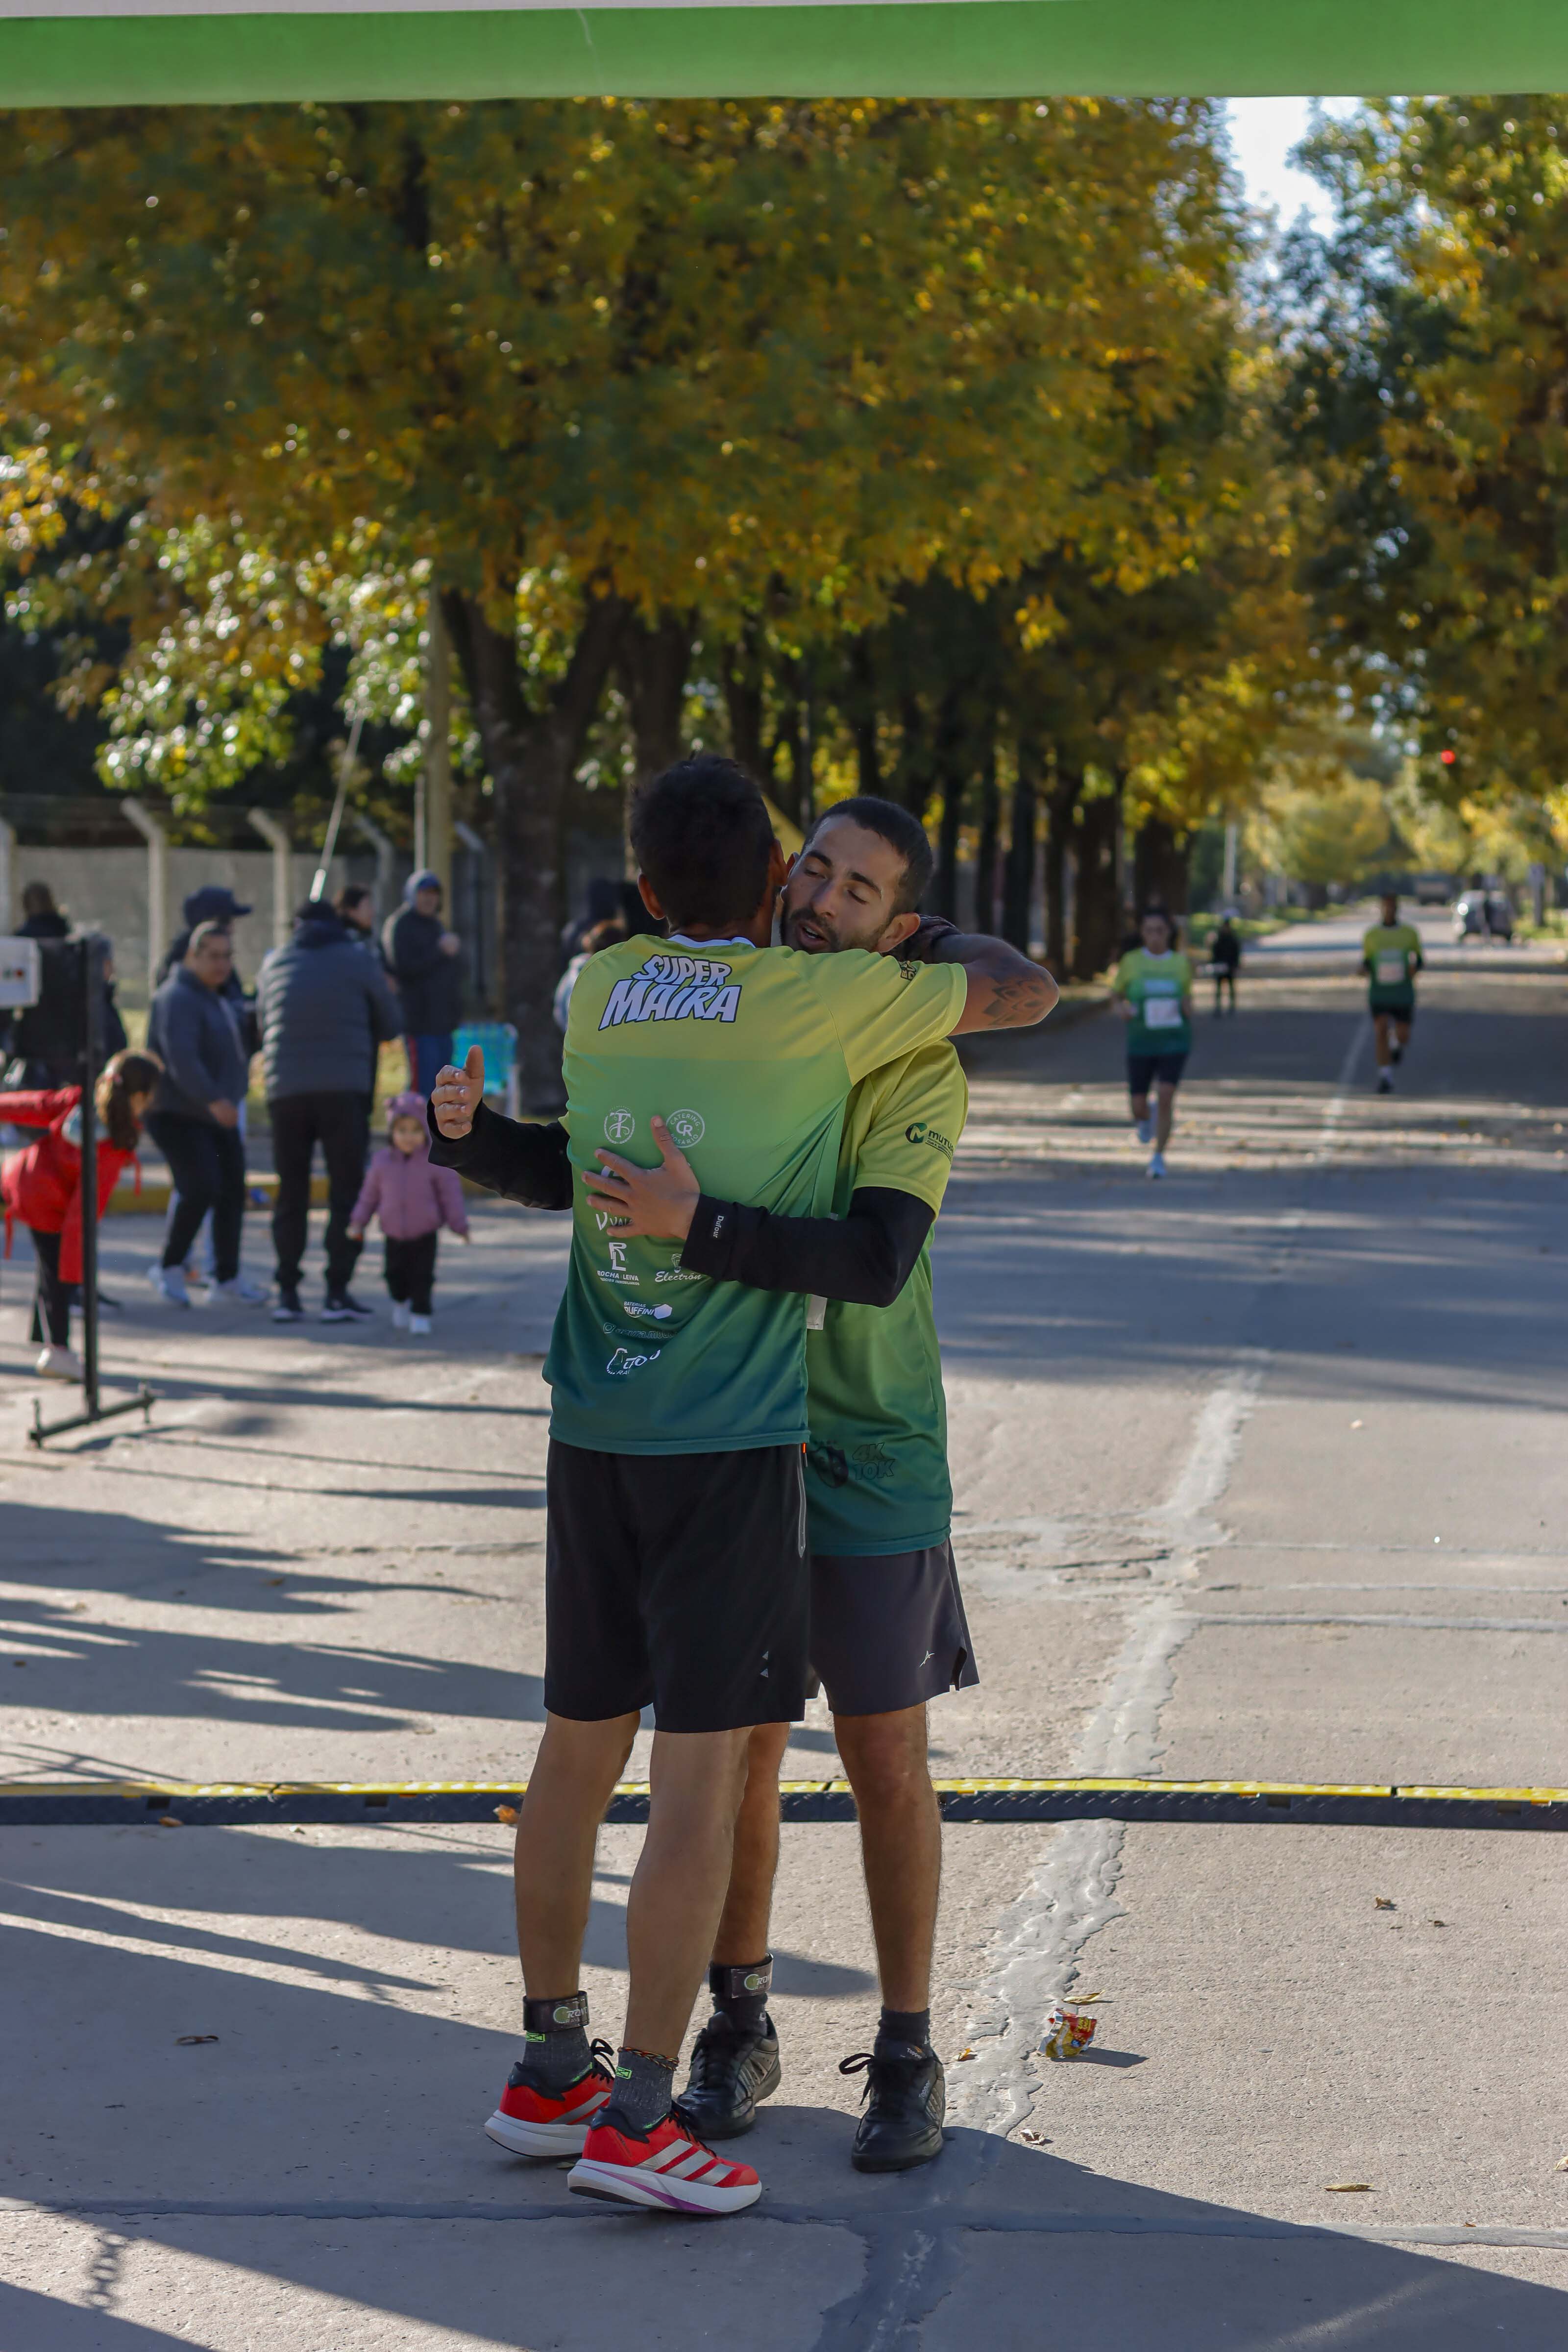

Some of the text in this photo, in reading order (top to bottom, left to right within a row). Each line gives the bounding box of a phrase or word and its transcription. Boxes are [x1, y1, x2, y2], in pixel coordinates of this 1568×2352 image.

[632, 954, 733, 986] SUPER
[598, 978, 742, 1031] MAIRA
[670, 1113, 701, 1126] CATERING
[713, 1215, 724, 1238] Dufour
[597, 1271, 620, 1279] ROCHA
[852, 1442, 885, 1462] 4K
[852, 1459, 896, 1480] 10K
